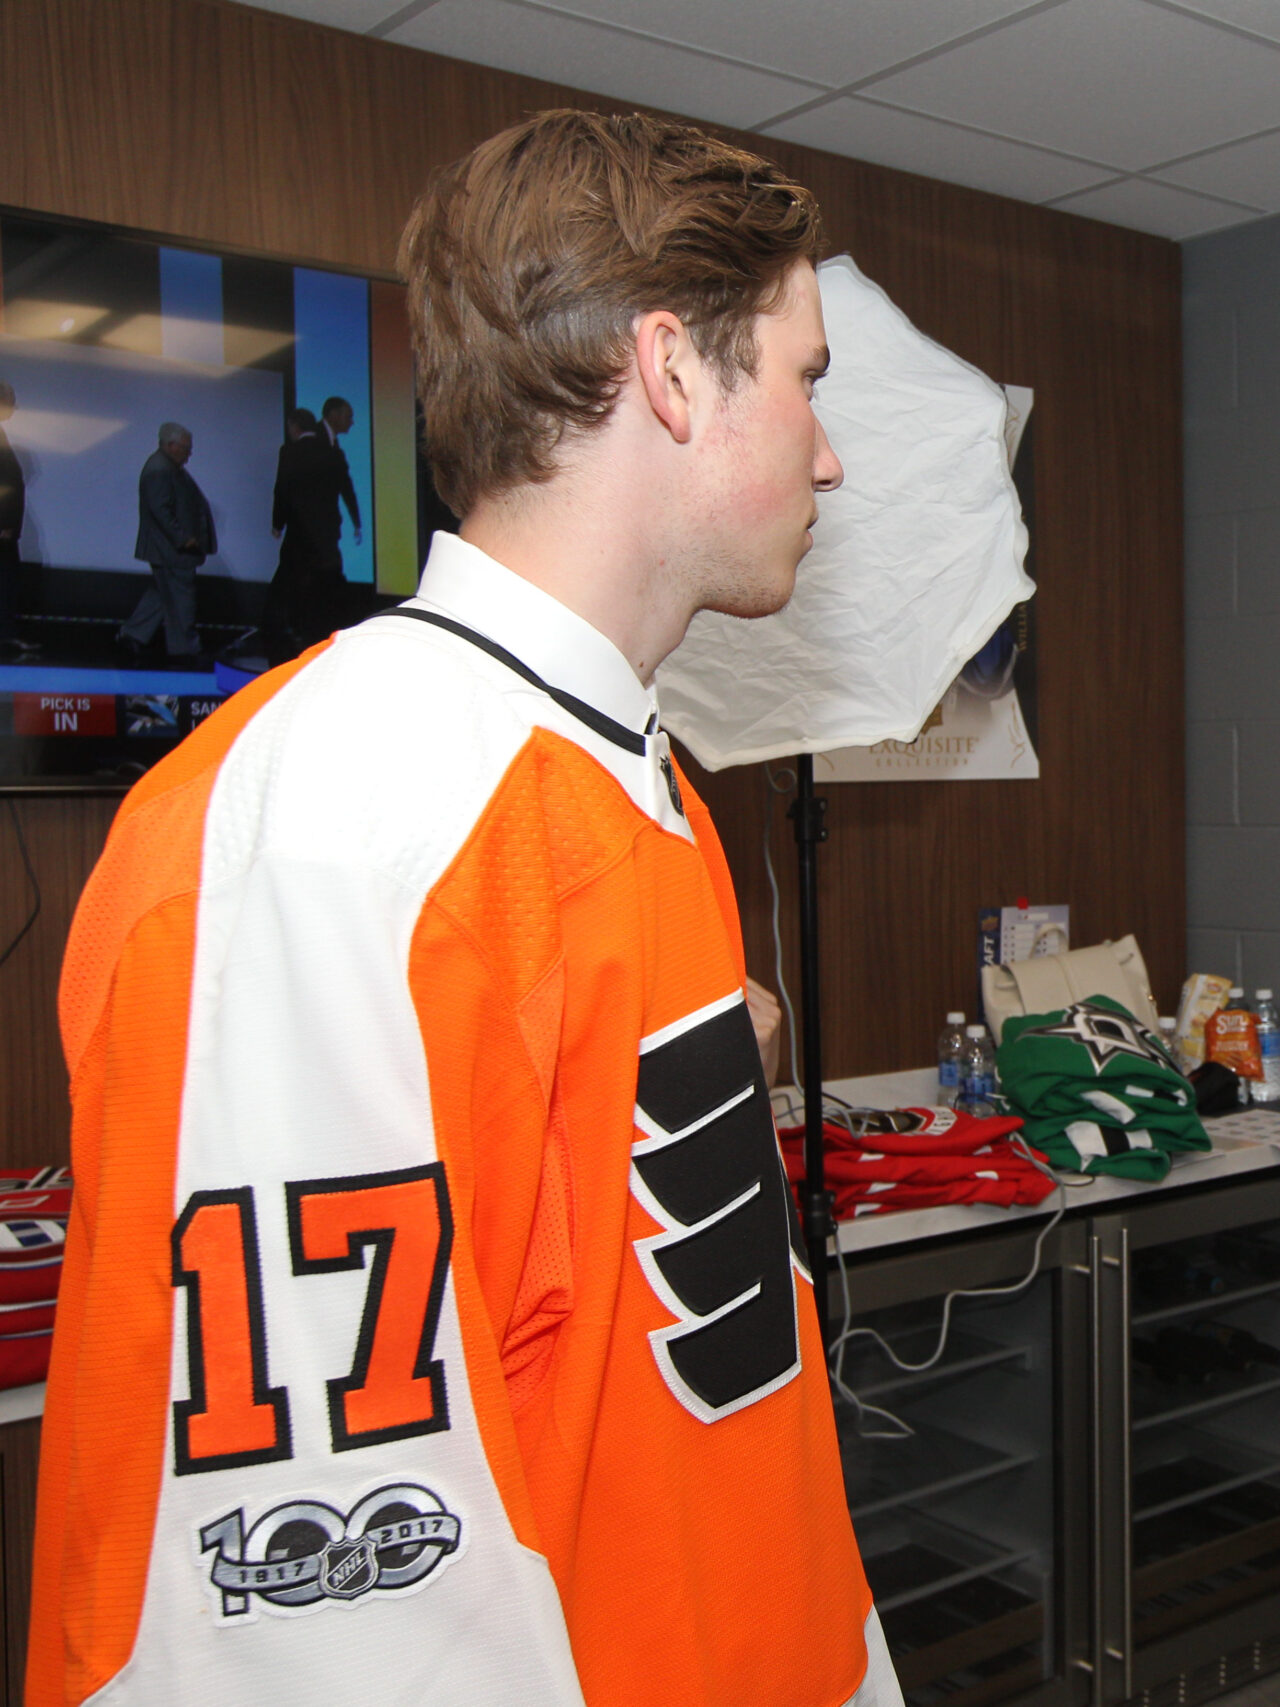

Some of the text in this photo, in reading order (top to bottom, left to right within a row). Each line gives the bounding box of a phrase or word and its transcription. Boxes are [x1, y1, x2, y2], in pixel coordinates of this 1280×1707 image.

[41, 697, 91, 712] PICK IS
[54, 712, 78, 732] IN
[982, 936, 996, 965] AFT
[170, 1161, 454, 1476] 17
[380, 1518, 444, 1544] 2017
[239, 1560, 307, 1584] 1917
[331, 1545, 366, 1588] NHL
